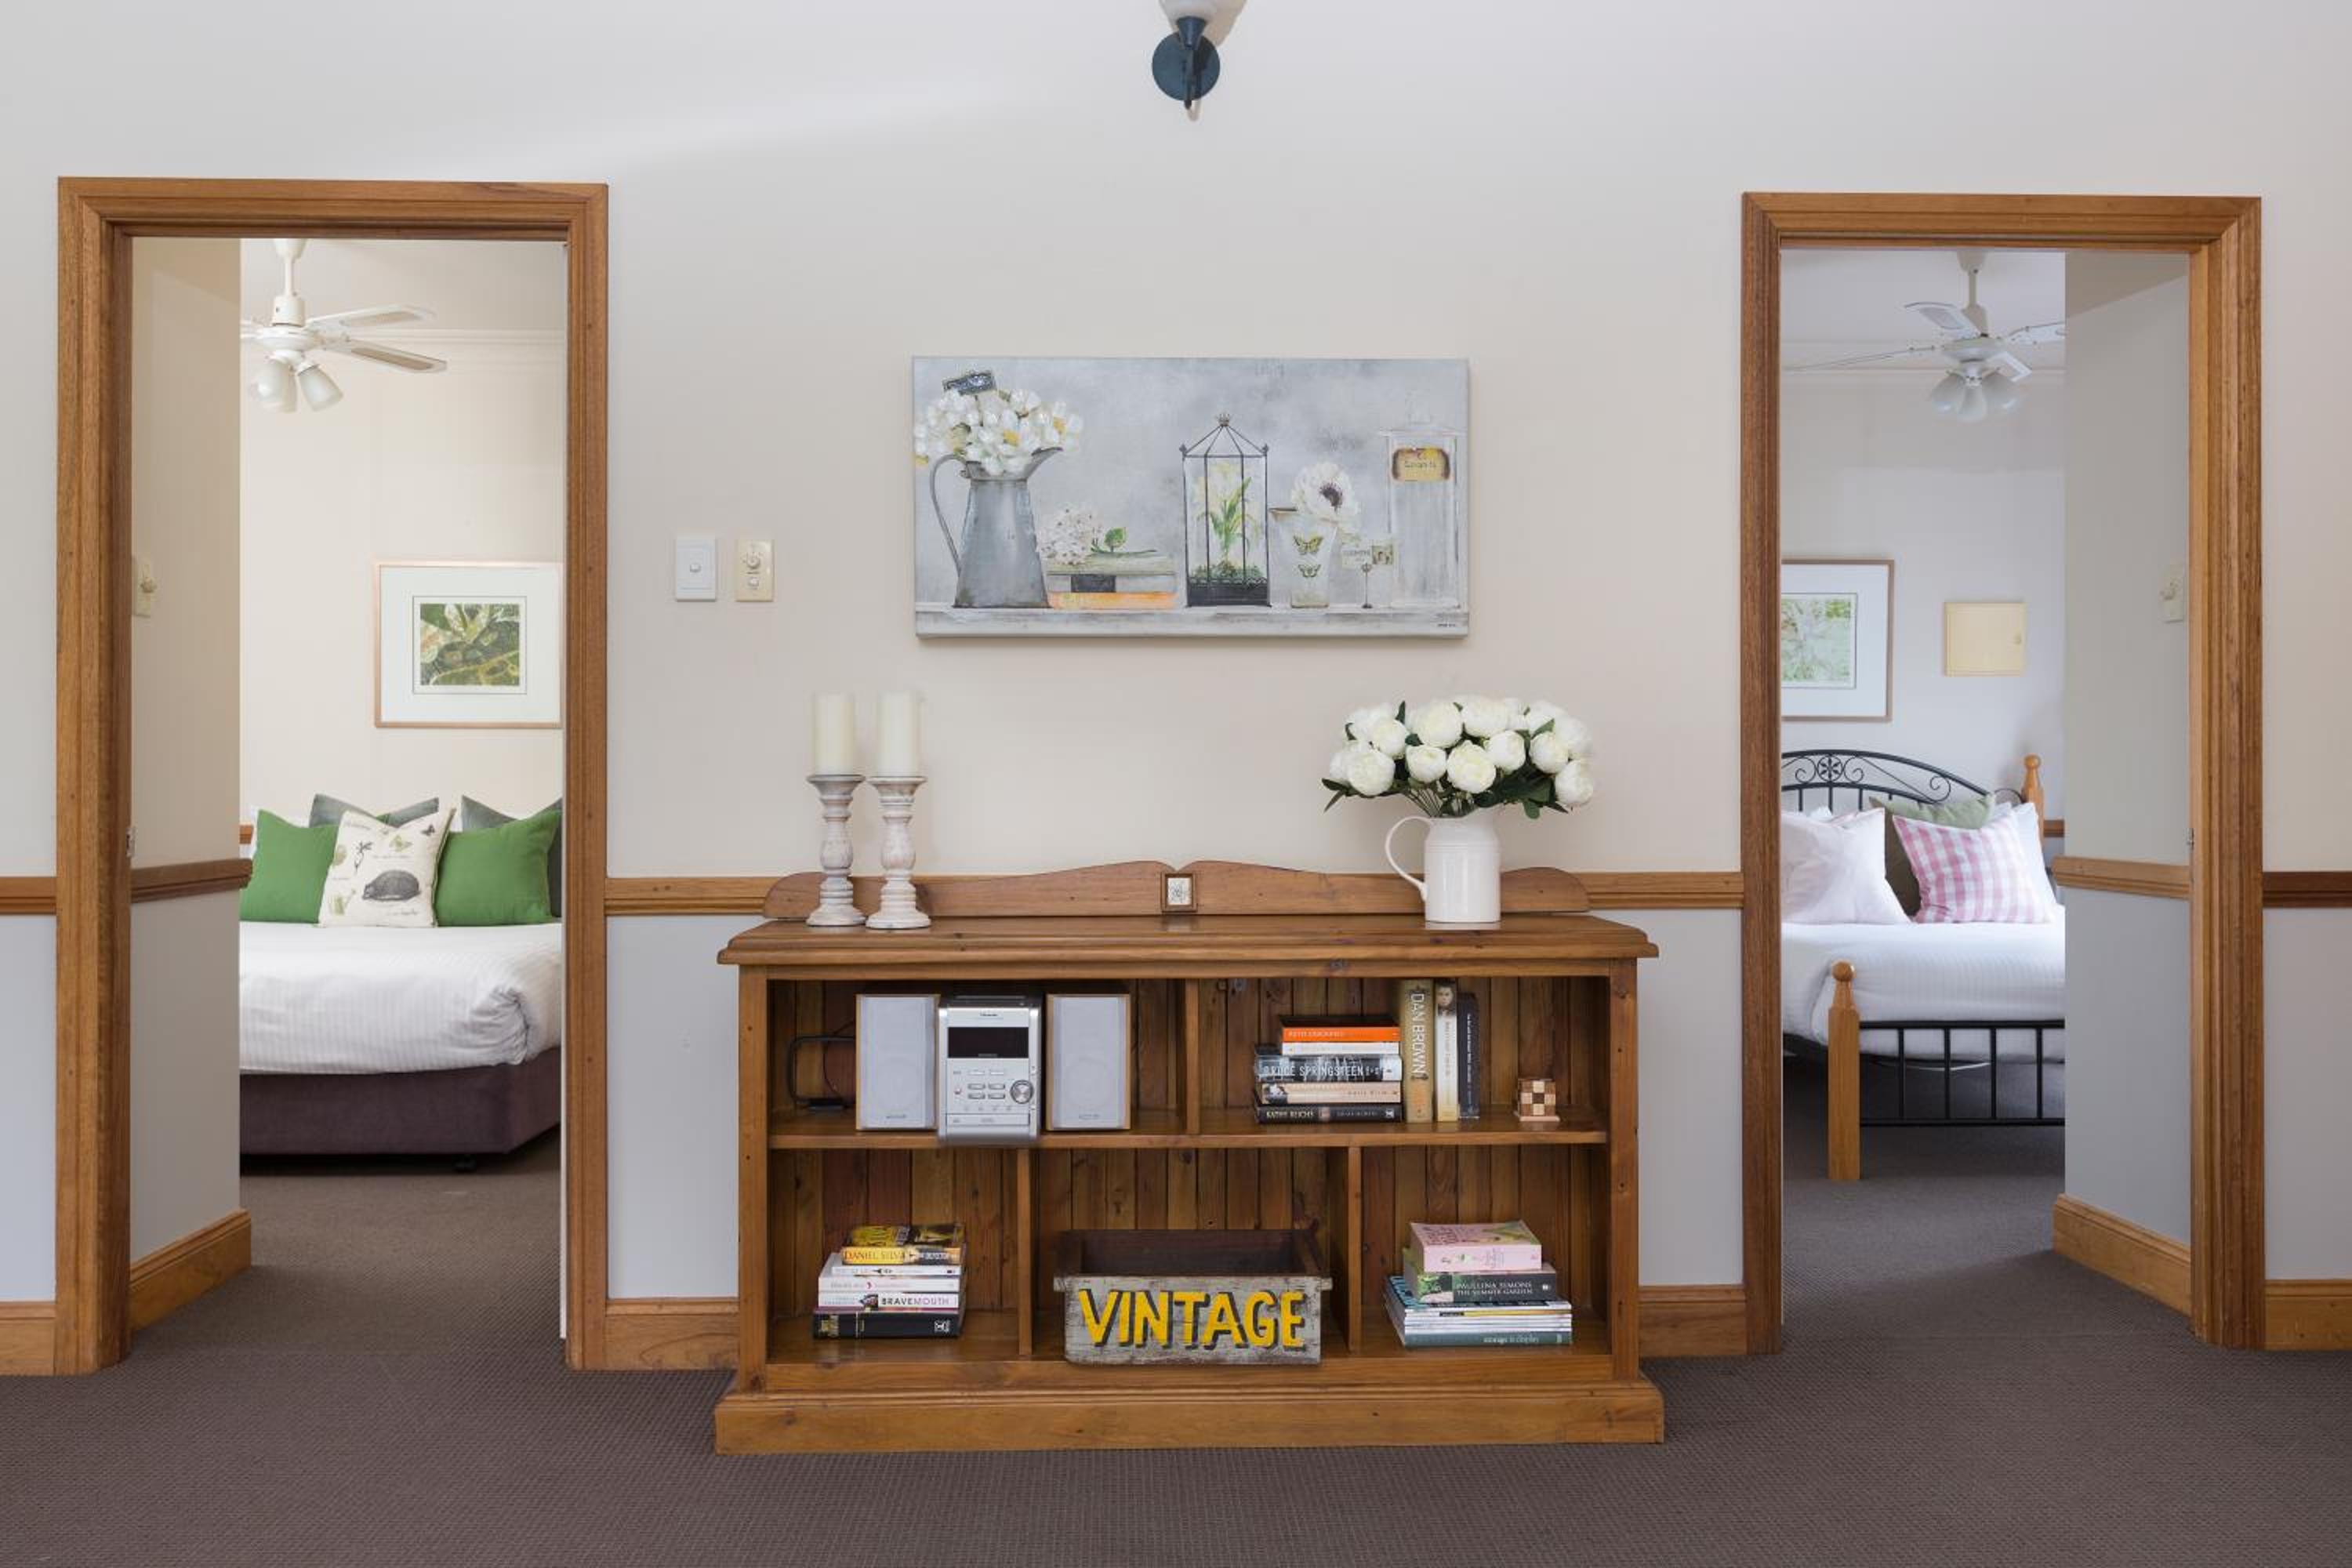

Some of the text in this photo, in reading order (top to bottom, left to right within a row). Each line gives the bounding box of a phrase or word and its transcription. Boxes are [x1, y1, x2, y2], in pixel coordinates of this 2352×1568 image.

[1411, 993, 1426, 1074] DAN BROWN
[1299, 1065, 1363, 1076] SPRINGSTEEN
[845, 1250, 879, 1261] DANIEL
[881, 1297, 949, 1306] BRAVEMOUTH
[1078, 1288, 1307, 1350] VINTAGE
